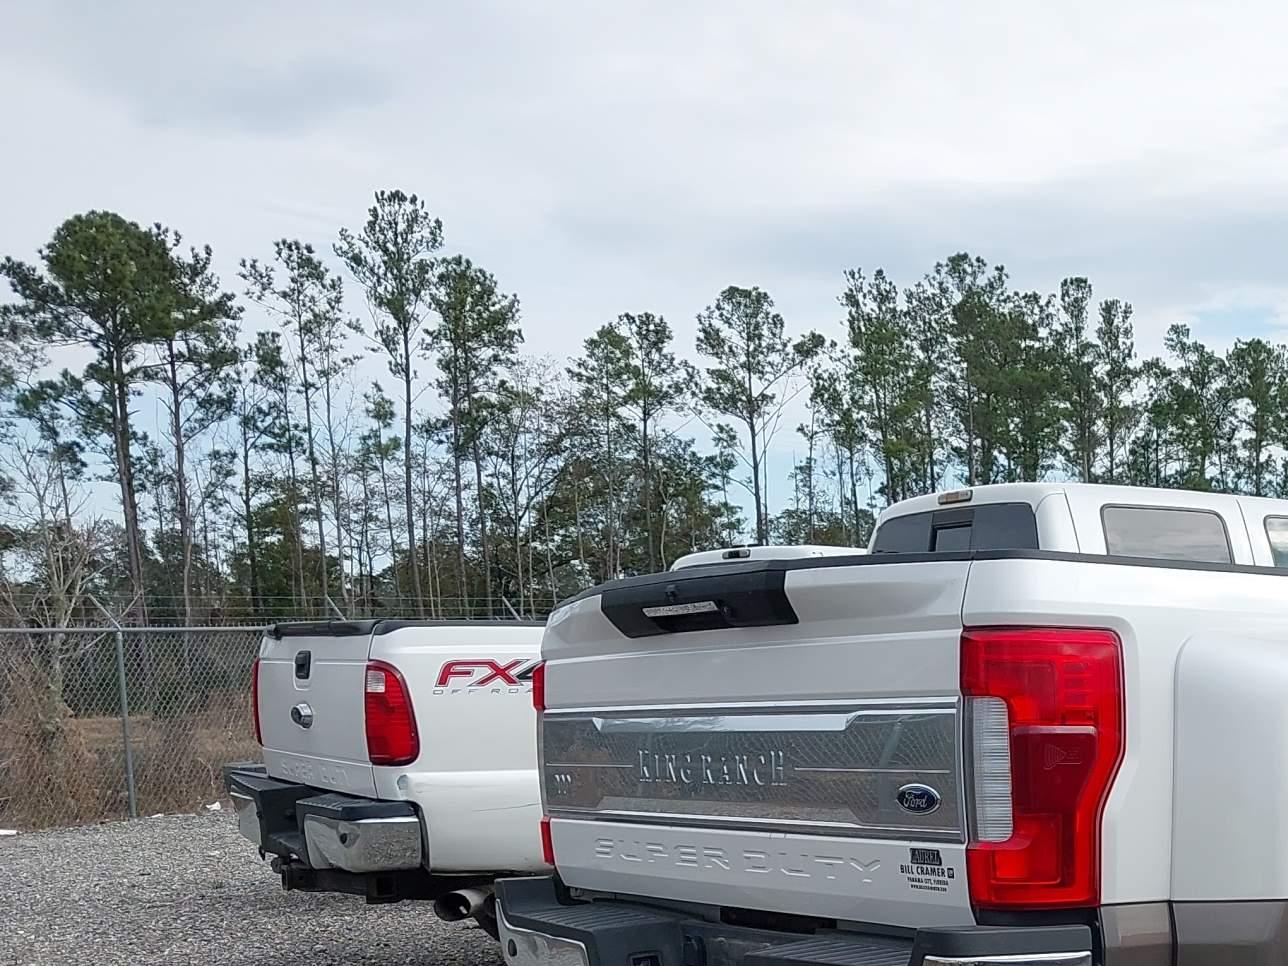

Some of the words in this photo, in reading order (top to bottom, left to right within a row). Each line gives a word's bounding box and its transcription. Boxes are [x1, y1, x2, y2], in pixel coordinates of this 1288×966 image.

[433, 688, 479, 696] OFF
[638, 750, 693, 784] KING
[700, 750, 788, 786] RANCH
[902, 789, 928, 809] Ford
[594, 837, 731, 870] SUPER
[742, 849, 881, 883] DUTY
[899, 864, 915, 875] BILL
[915, 865, 947, 878] CRAMER
